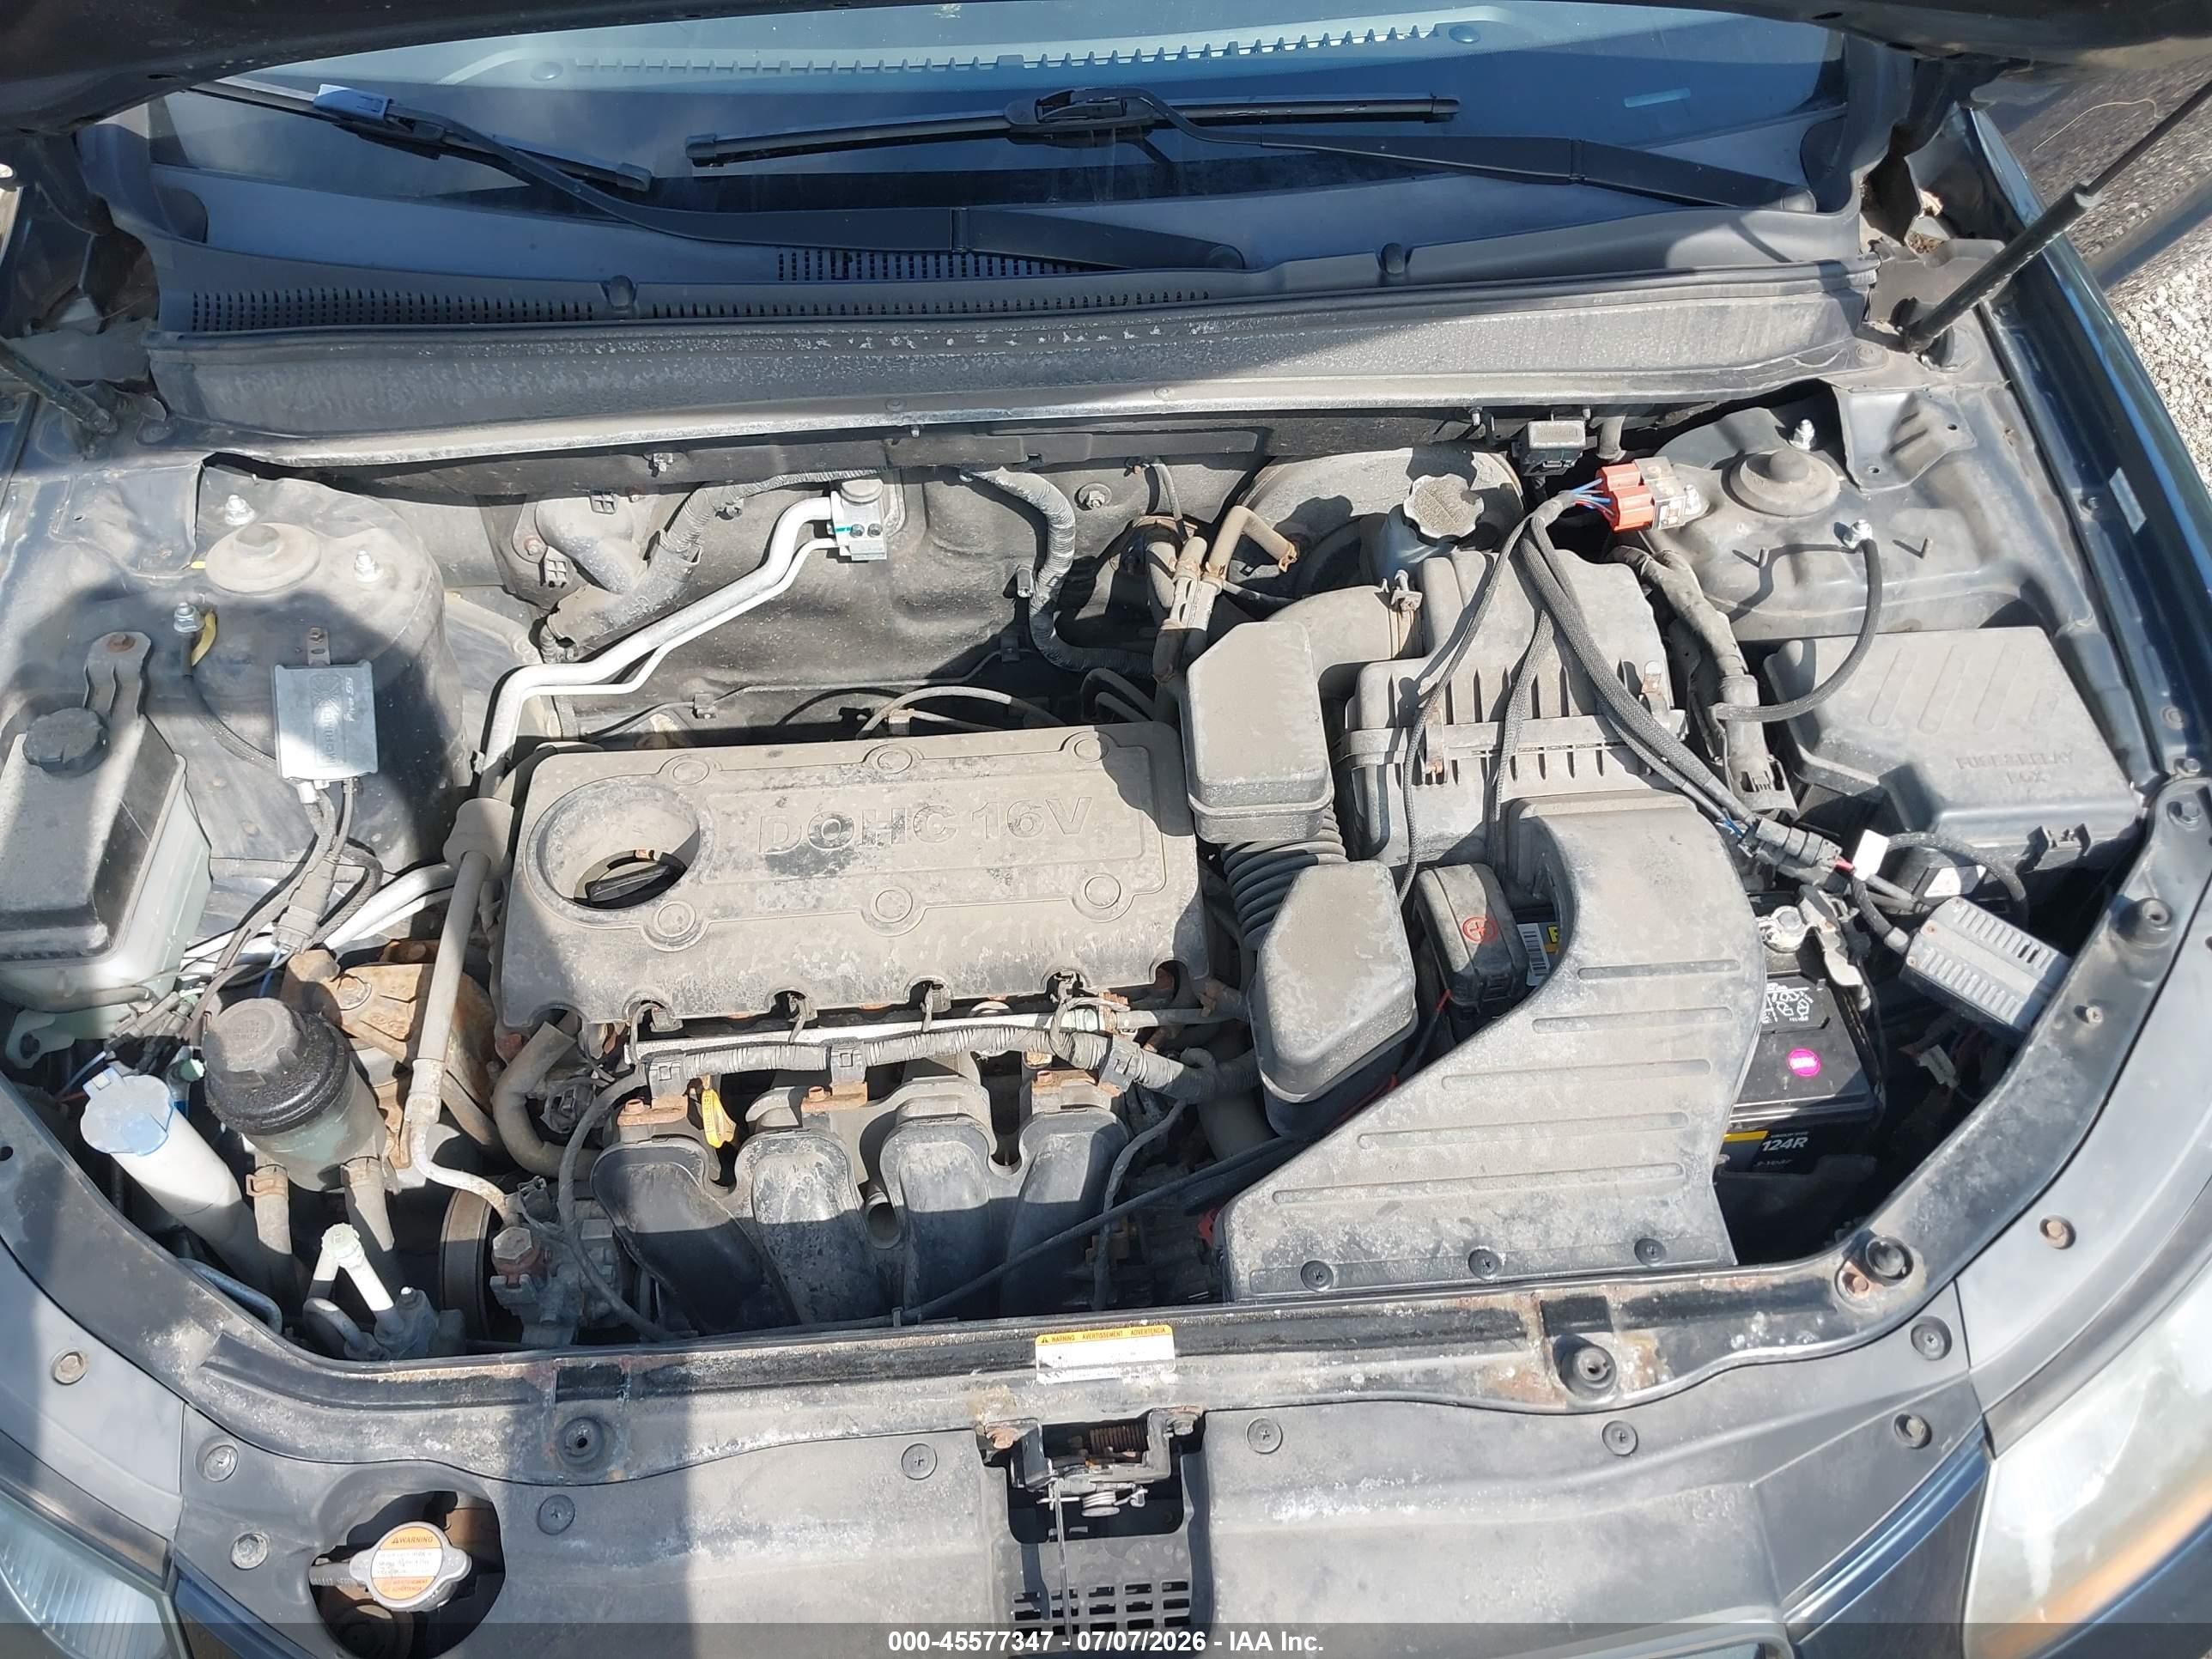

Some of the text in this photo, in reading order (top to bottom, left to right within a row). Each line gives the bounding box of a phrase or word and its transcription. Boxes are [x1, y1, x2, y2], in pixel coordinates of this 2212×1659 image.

[757, 796, 1093, 854] DOHC 16V
[1761, 1136, 1809, 1152] 124R
[1051, 1327, 1166, 1343] WARNING AVERTISSEMENT ADVERTENCIA
[399, 1535, 433, 1544] WARNING
